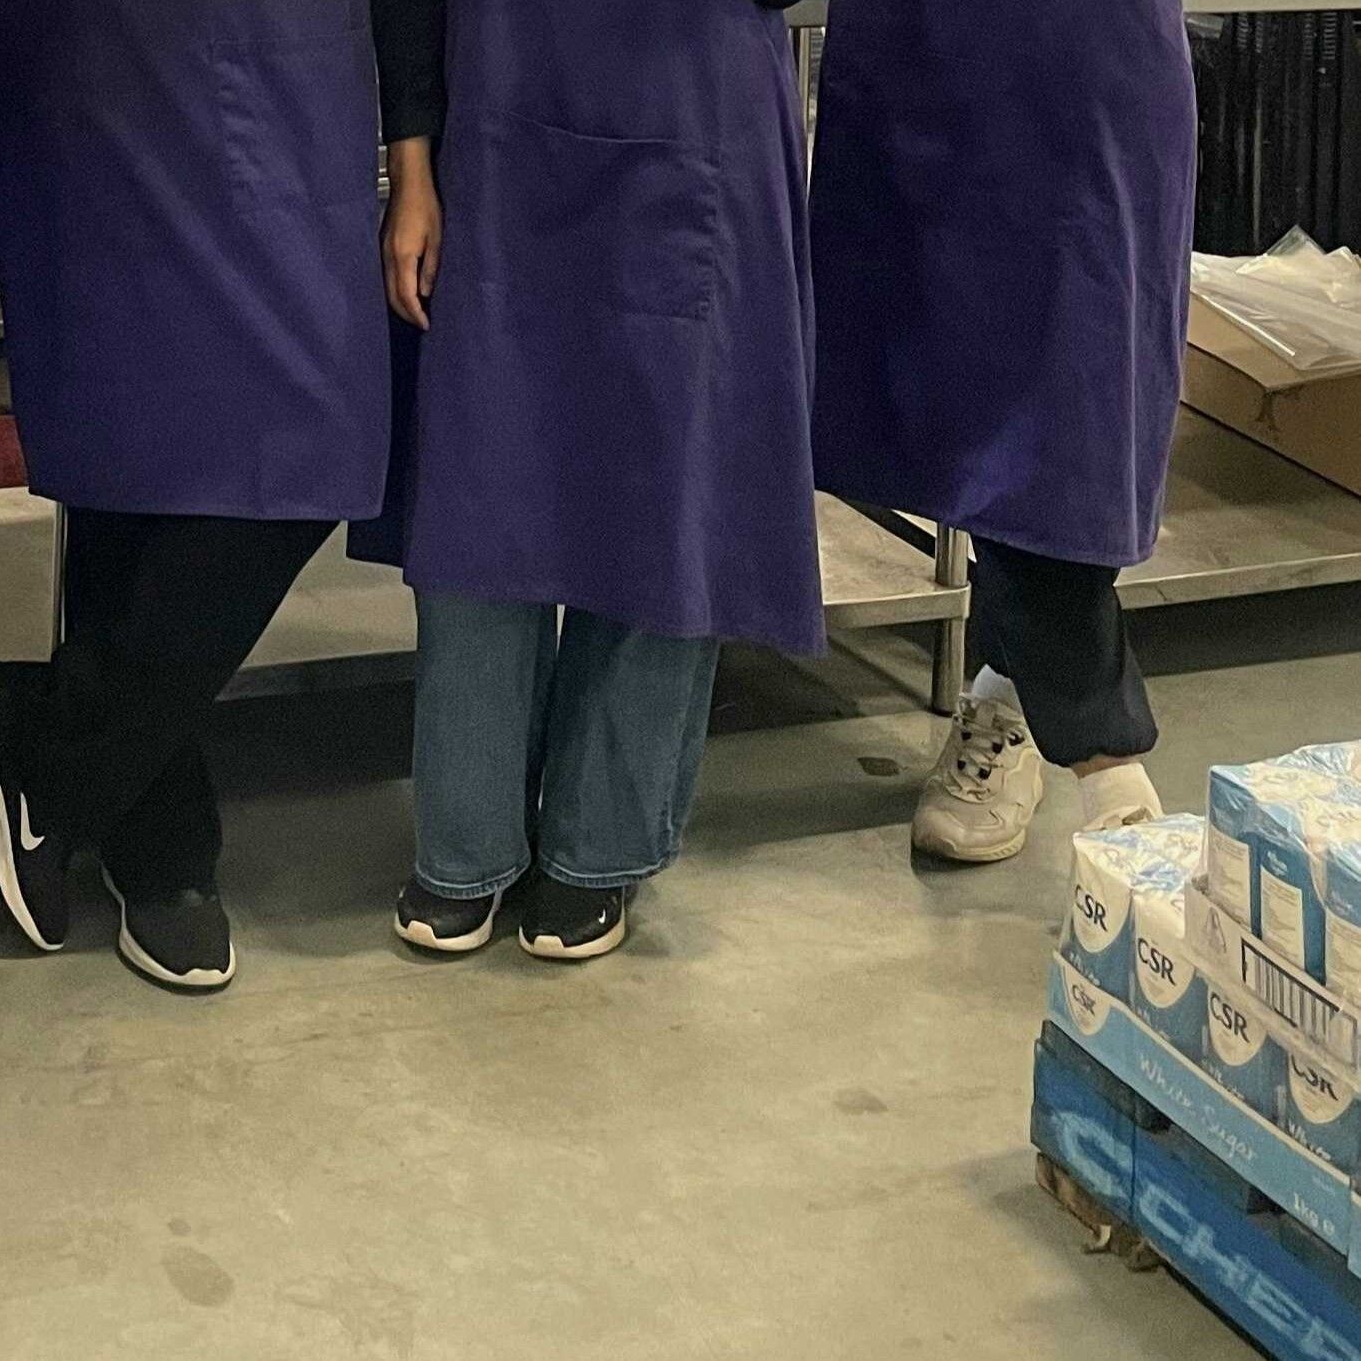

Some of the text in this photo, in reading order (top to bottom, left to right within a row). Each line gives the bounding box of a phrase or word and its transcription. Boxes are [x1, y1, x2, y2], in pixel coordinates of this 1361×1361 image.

[1075, 885, 1108, 933] CSR
[1138, 937, 1177, 987] CSR
[1210, 991, 1251, 1044] CSR
